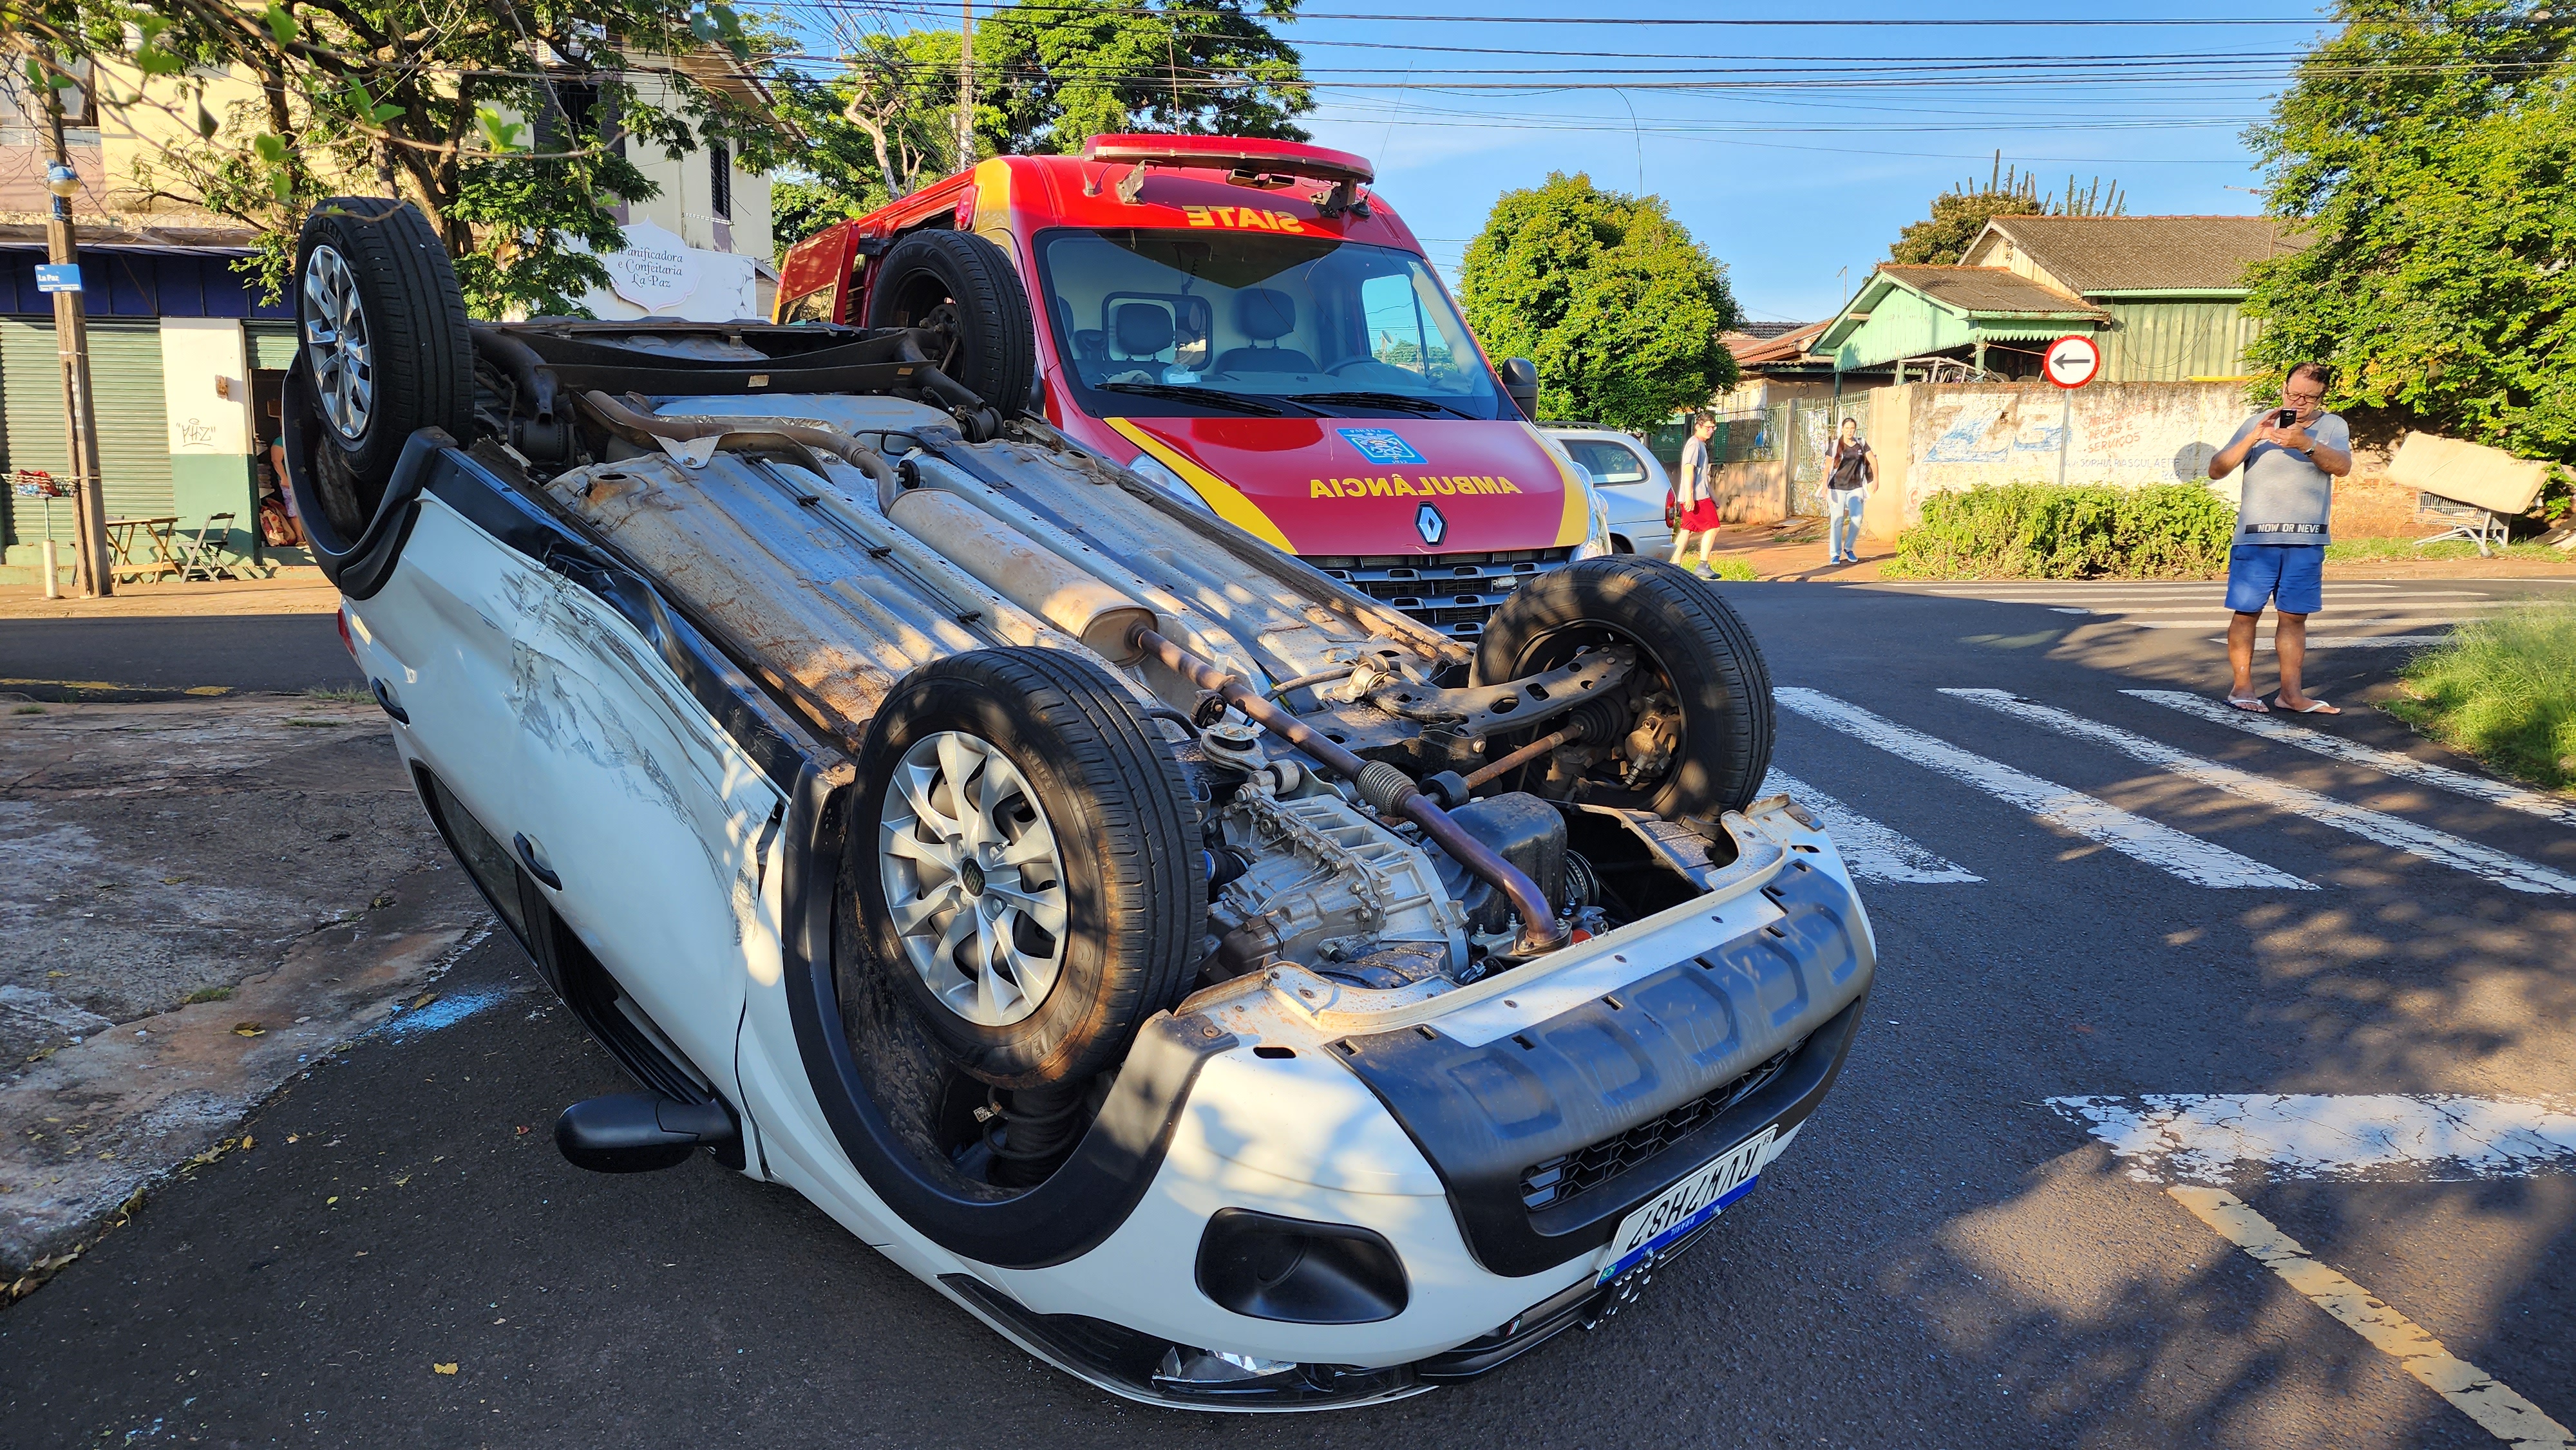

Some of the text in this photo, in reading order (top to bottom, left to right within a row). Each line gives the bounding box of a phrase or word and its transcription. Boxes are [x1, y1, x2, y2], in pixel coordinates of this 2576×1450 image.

[626, 259, 683, 276] Confeitaria
[632, 273, 670, 288] La Paz
[2258, 523, 2280, 532] NOW
[2282, 523, 2295, 532] OR
[1009, 730, 1055, 791] MAXLIFE
[963, 863, 985, 893] FIAT
[1625, 1142, 1761, 1254] RVW7H87
[1670, 1215, 1697, 1237] BRASIL
